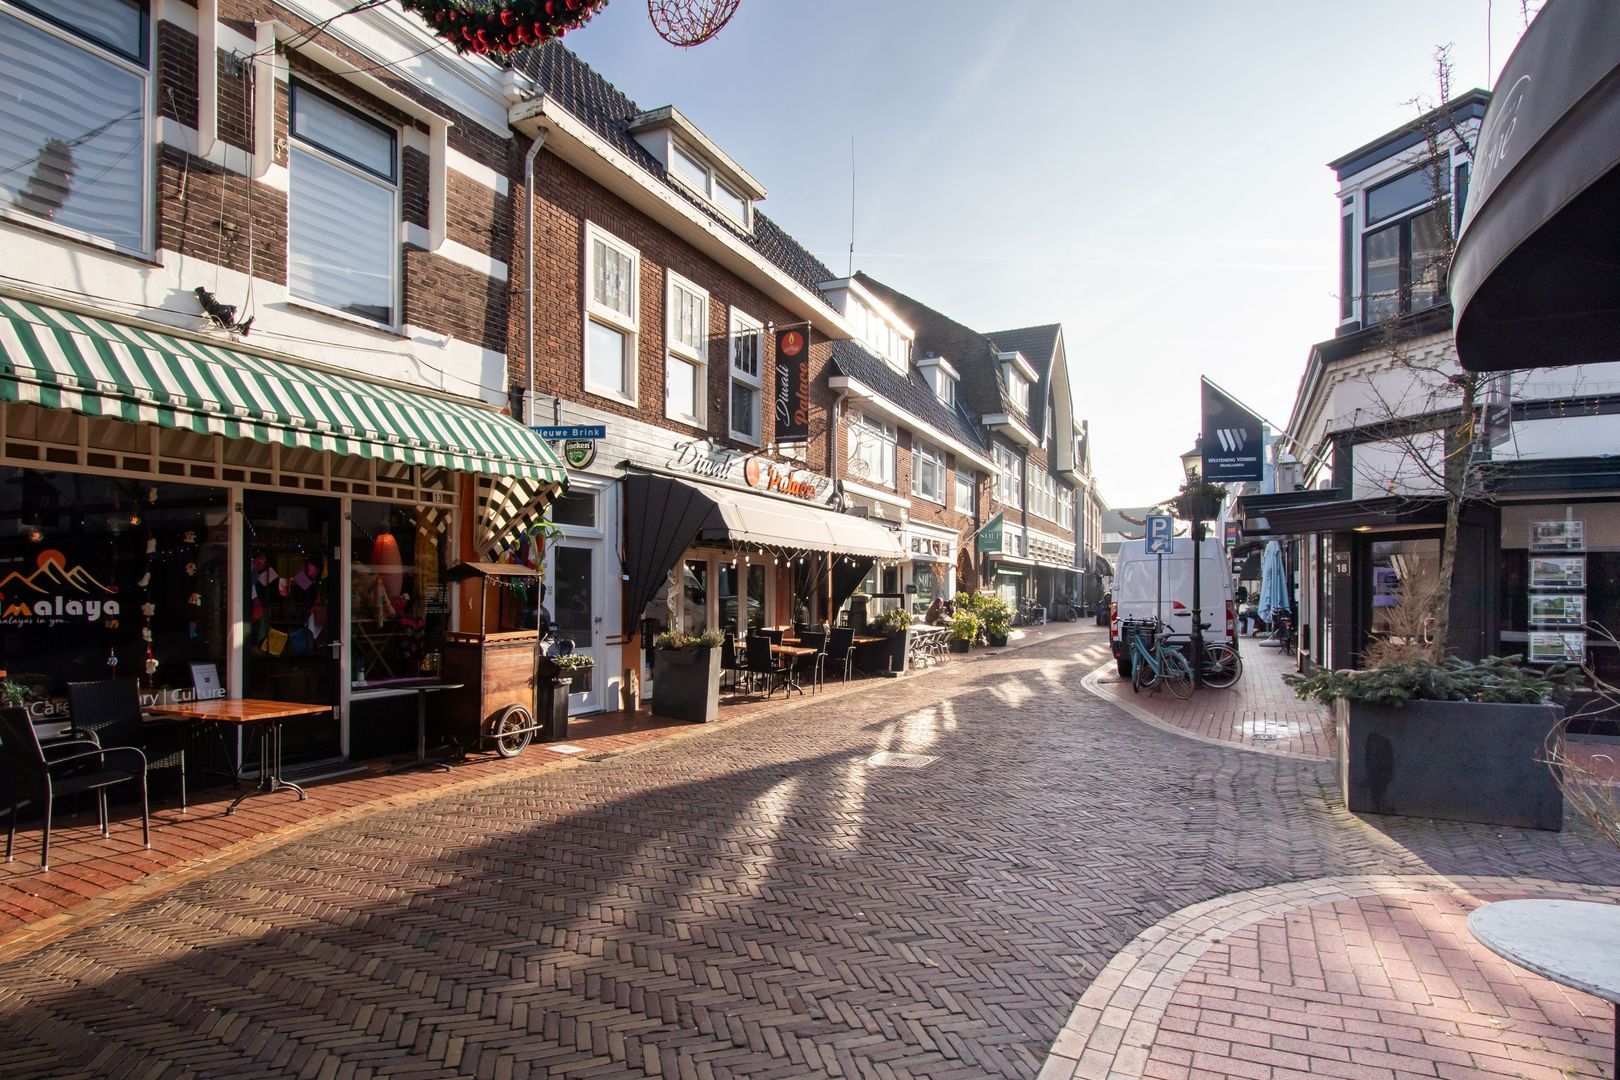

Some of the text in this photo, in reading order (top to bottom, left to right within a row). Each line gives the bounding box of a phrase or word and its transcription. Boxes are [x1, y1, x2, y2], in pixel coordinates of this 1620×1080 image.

[776, 364, 790, 427] Diwali
[795, 362, 808, 426] Palace
[572, 428, 600, 436] Brink
[665, 440, 817, 500] Diwali Palace
[1152, 519, 1167, 538] P
[1336, 563, 1348, 573] 18
[0, 593, 120, 621] malaya
[171, 686, 226, 702] Culture
